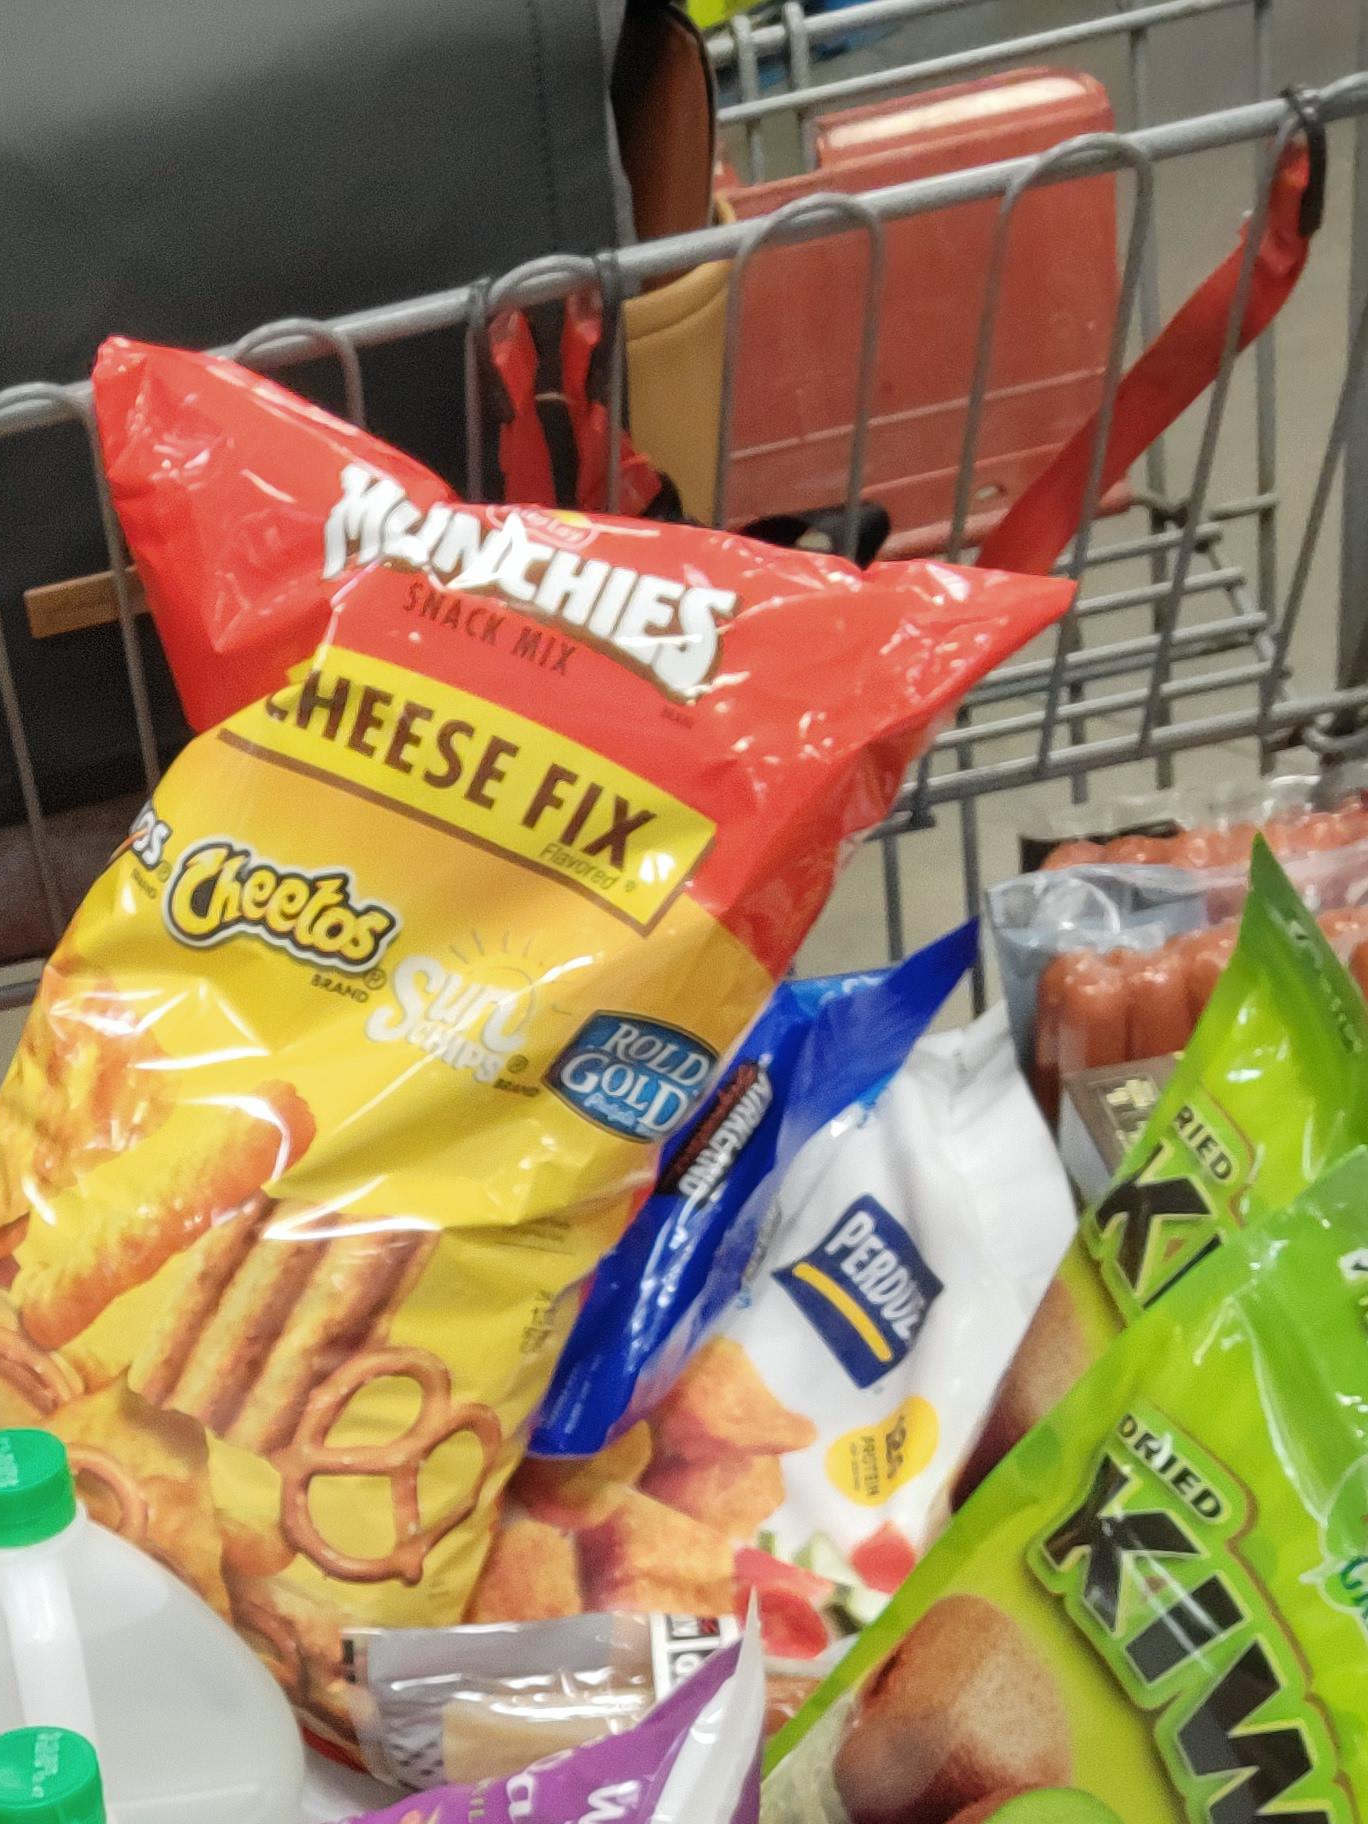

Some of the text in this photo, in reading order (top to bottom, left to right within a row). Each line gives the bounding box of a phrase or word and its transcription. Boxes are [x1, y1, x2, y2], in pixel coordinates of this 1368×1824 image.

[321, 465, 743, 703] MUNCHIES
[402, 581, 581, 678] SNACK MIX
[525, 764, 660, 872] FIX
[539, 842, 621, 891] Flavored
[169, 843, 396, 969] Cheetos
[311, 972, 370, 1004] BRAND
[560, 1052, 690, 1134] GOLD
[602, 1021, 712, 1088] ROLD
[1173, 1104, 1235, 1181] RIED
[823, 1209, 929, 1344] PERDUE
[1116, 1411, 1224, 1520] DRIED
